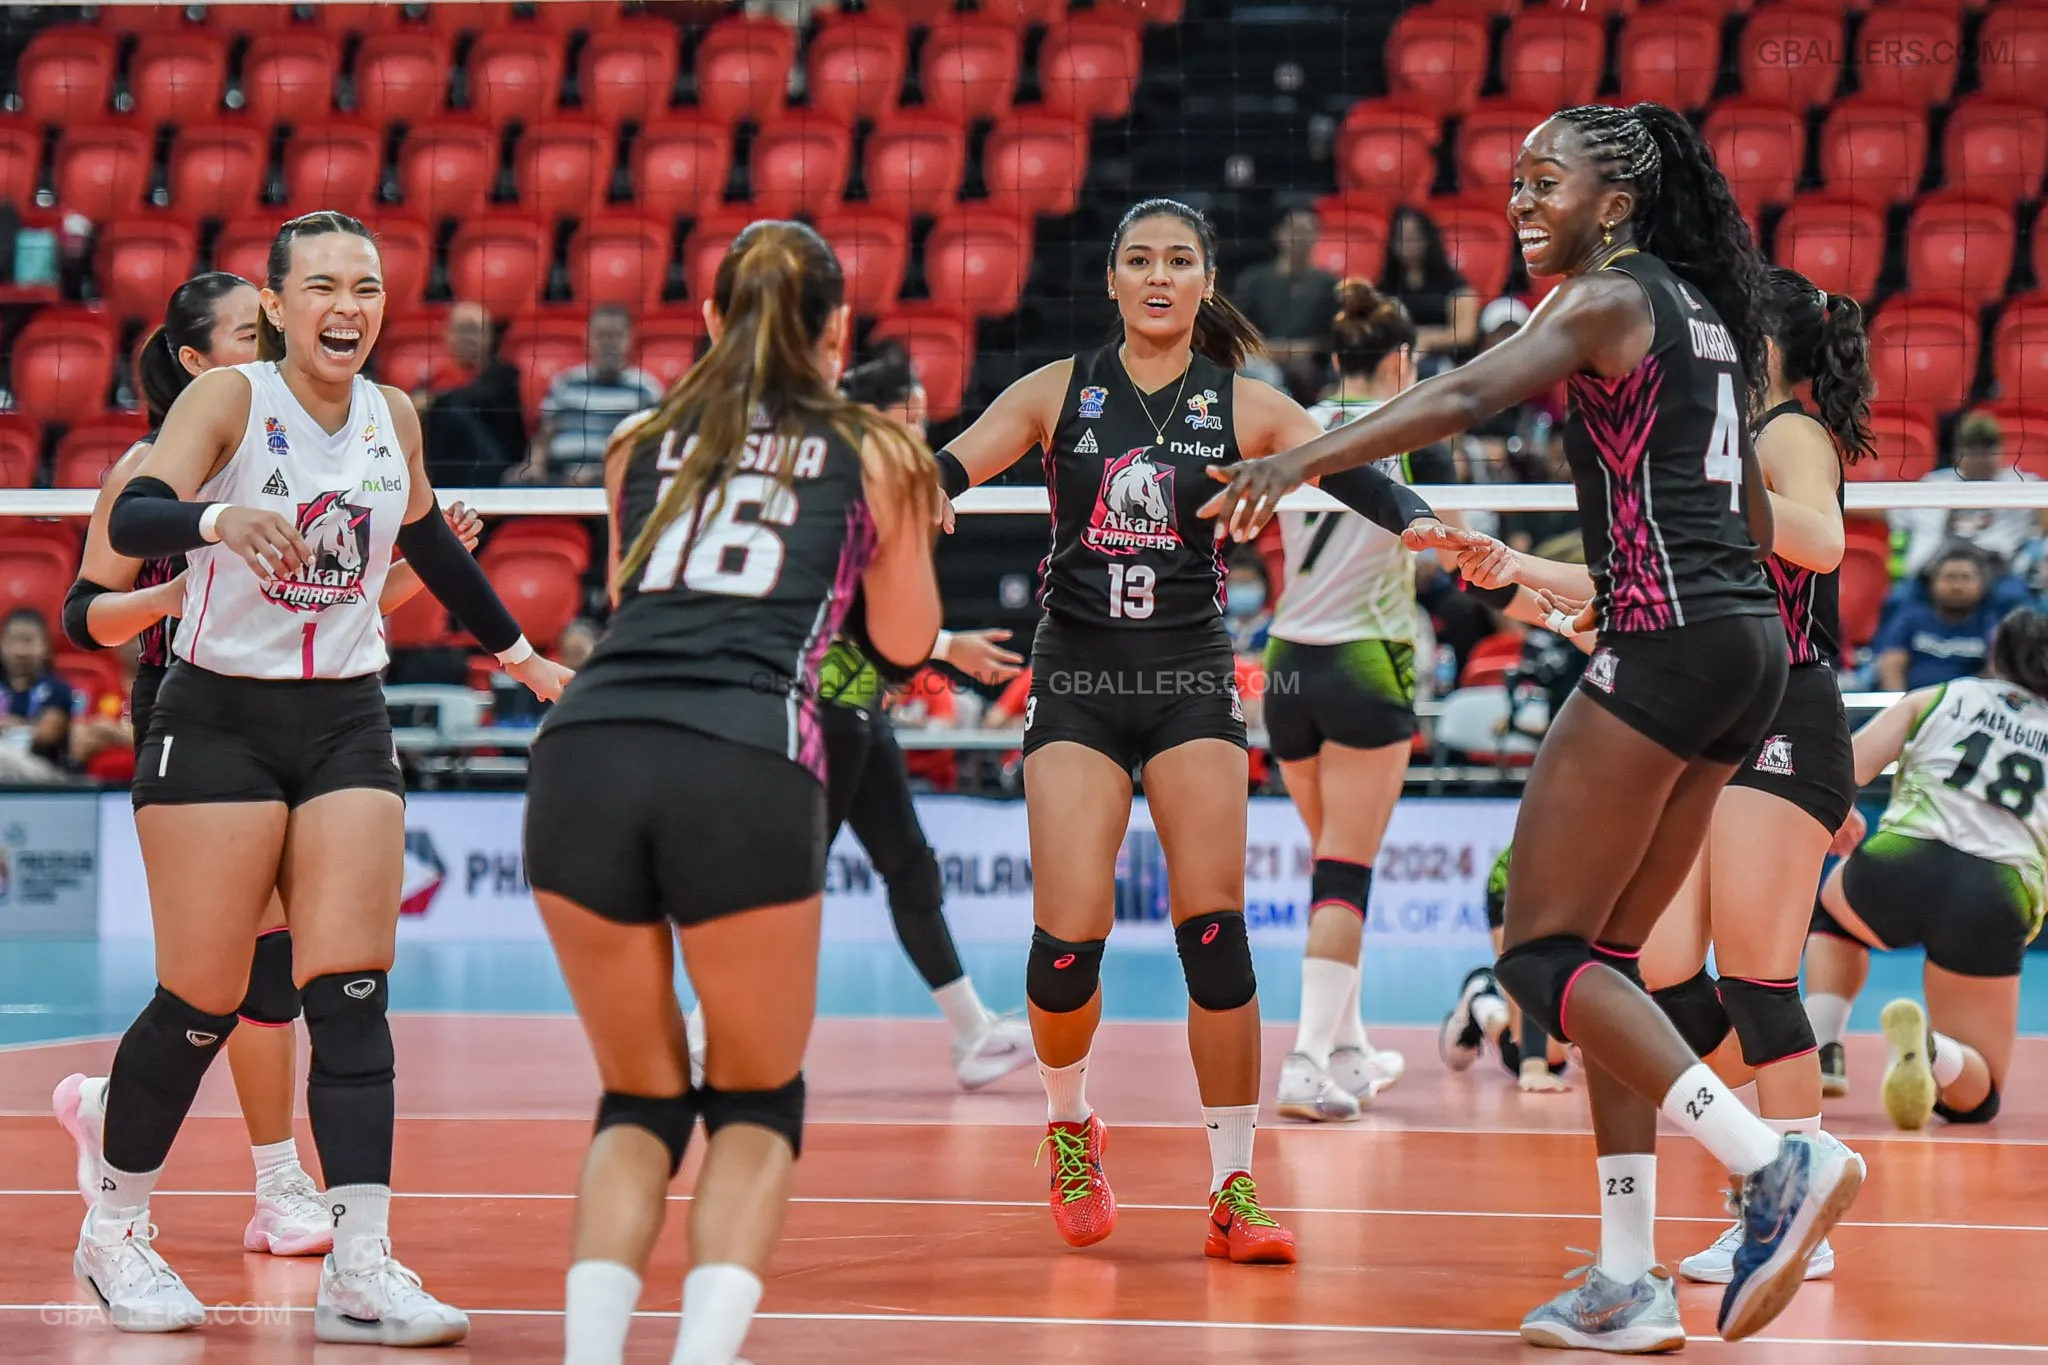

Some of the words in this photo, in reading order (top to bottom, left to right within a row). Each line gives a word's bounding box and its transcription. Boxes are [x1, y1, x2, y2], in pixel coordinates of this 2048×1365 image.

[1687, 316, 1738, 363] OKARO
[1206, 416, 1223, 429] PVL
[1073, 446, 1099, 454] DELTA
[1170, 440, 1225, 458] nxled
[1704, 372, 1742, 513] 4
[261, 486, 289, 498] DELTA
[361, 475, 402, 492] nxled
[637, 474, 799, 598] 16
[1101, 510, 1168, 534] Akari
[1086, 527, 1178, 551] CHARGERS
[268, 580, 359, 606] CHARGERS
[1108, 562, 1157, 620] 13
[301, 622, 318, 679] 1
[158, 735, 174, 777] 1
[1943, 731, 2046, 820] 18
[1380, 846, 1475, 881] 2024
[1686, 1086, 1715, 1121] 23
[1607, 1176, 1635, 1196] 23
